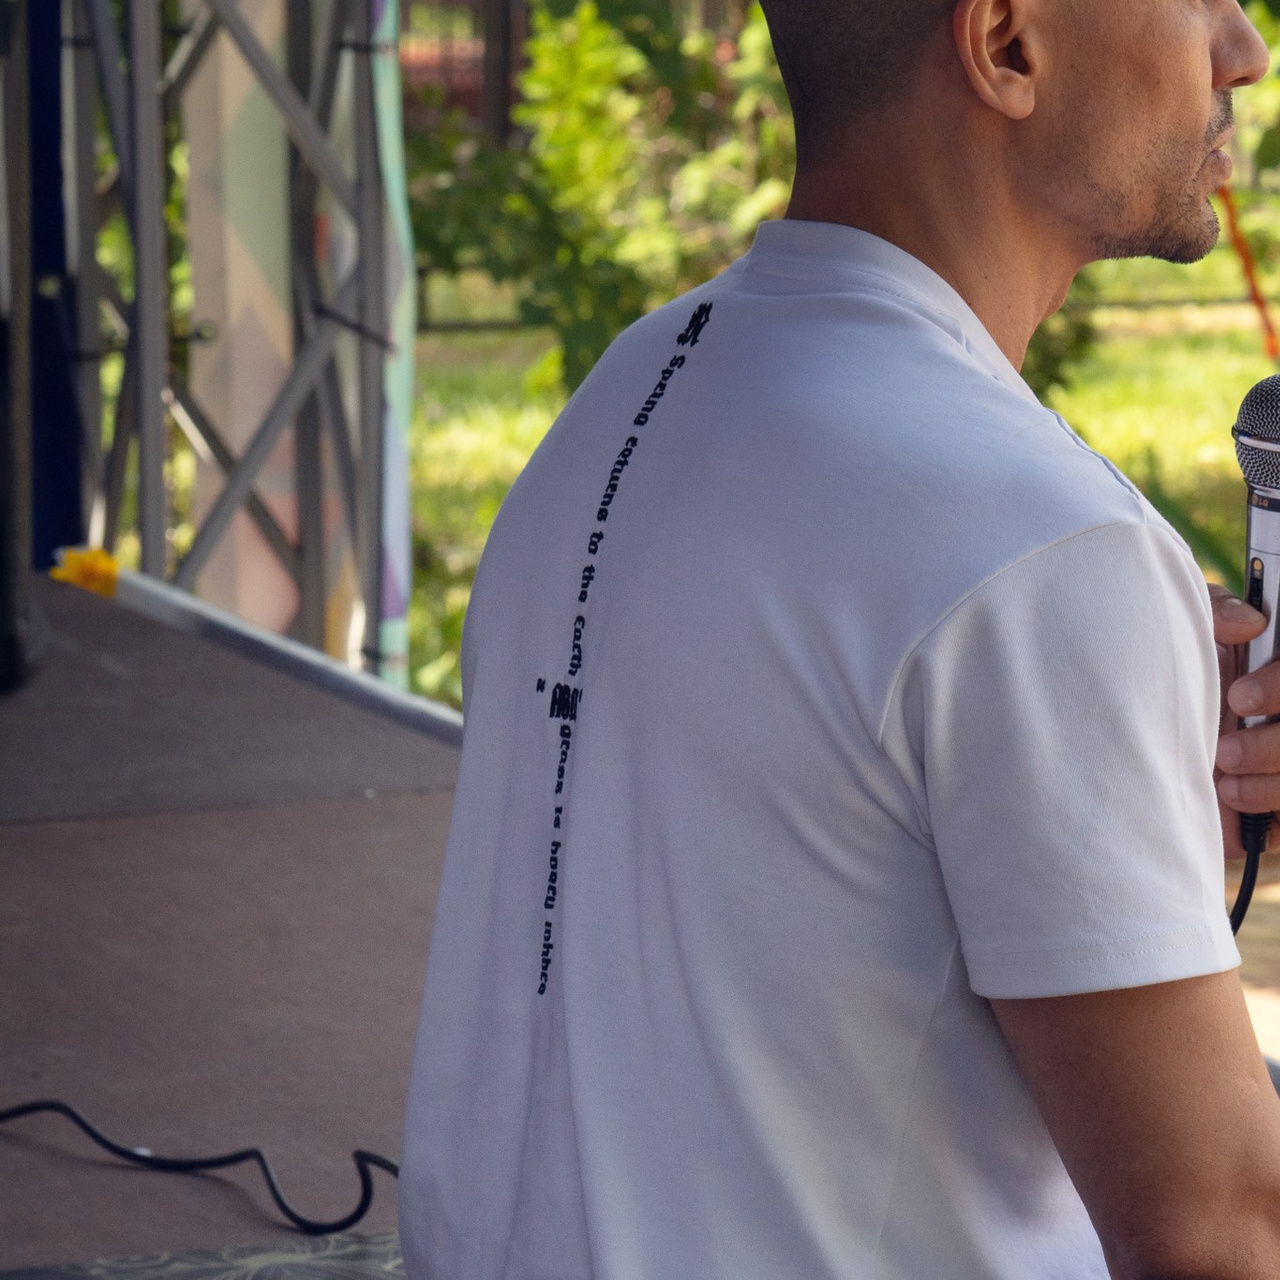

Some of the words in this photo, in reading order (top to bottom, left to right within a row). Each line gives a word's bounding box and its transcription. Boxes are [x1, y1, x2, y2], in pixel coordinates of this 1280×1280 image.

[633, 354, 686, 427] Spring
[587, 531, 604, 555] to
[578, 564, 596, 603] the
